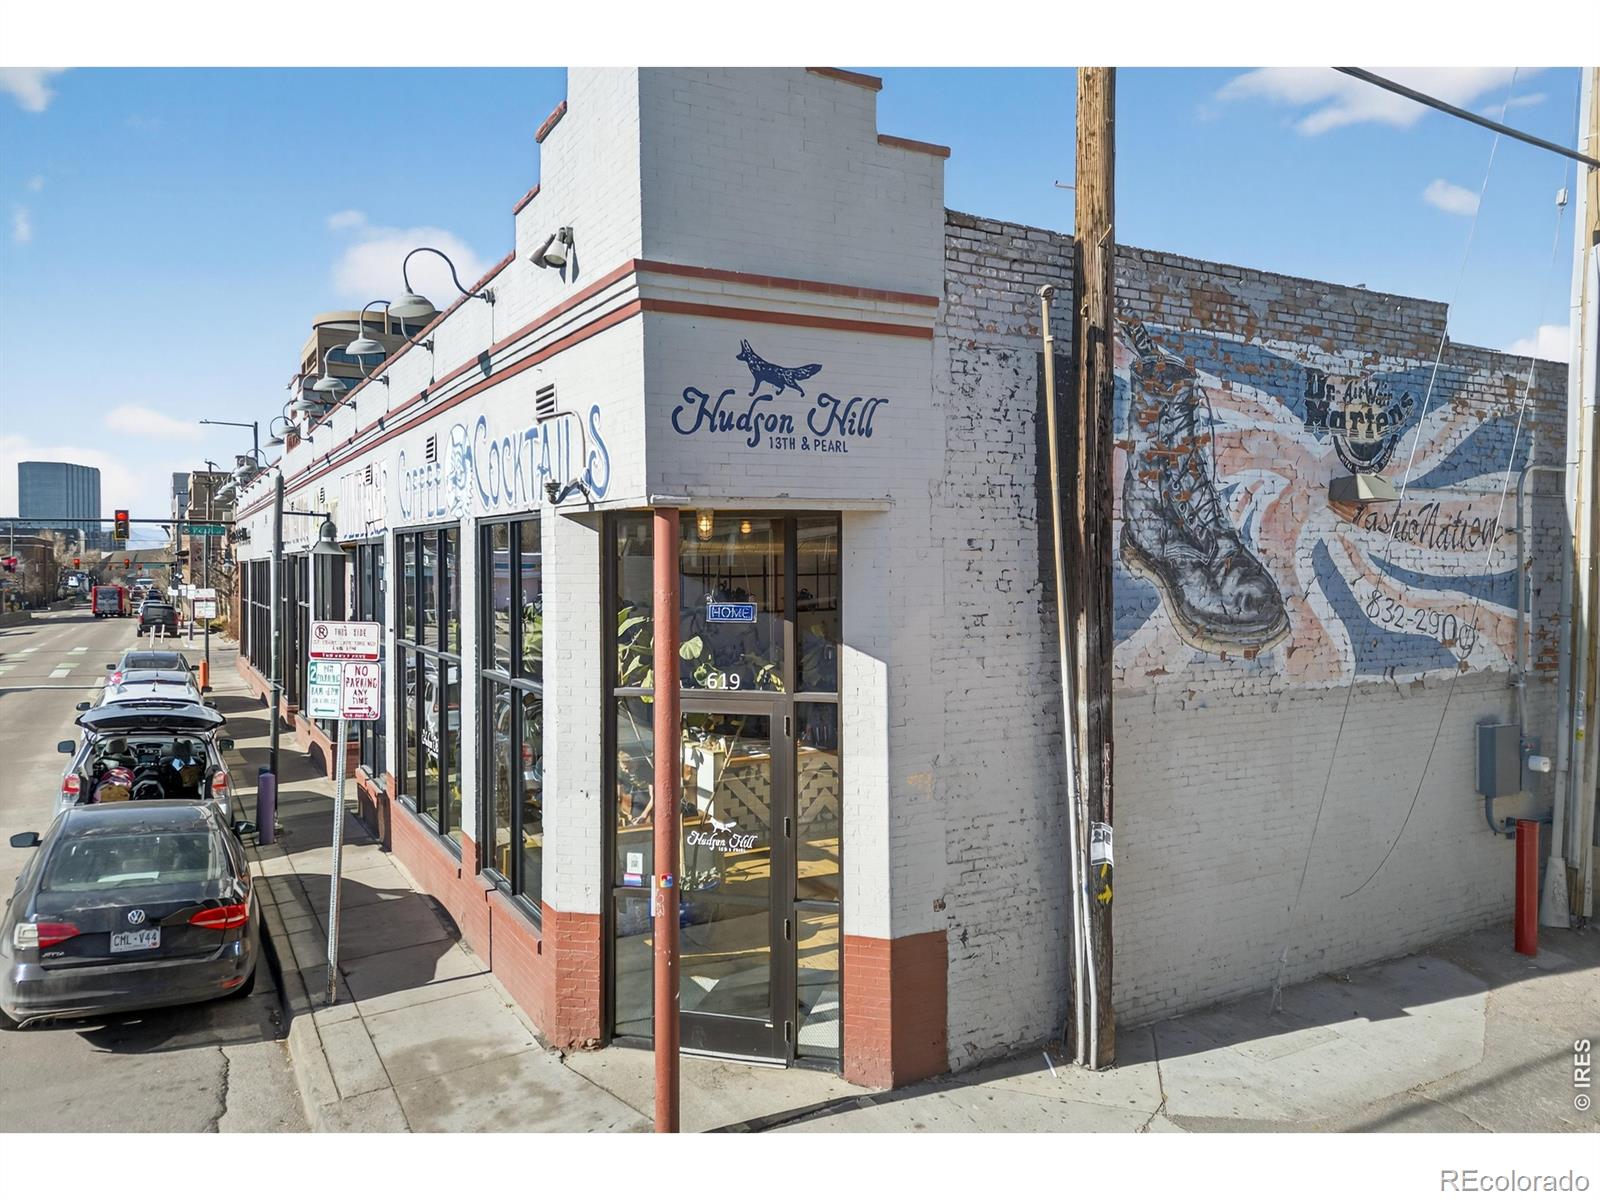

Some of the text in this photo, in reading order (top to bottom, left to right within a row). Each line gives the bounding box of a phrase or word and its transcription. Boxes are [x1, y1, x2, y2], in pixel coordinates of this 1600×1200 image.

[671, 386, 889, 448] Hudson Hill
[769, 436, 848, 453] 13TH & PEARL
[474, 404, 611, 510] COCKTAILS
[711, 605, 752, 619] HOME
[354, 665, 369, 677] NO
[345, 677, 378, 689] PARKING
[707, 672, 741, 690] 619
[352, 688, 368, 697] ANY
[729, 833, 758, 849] Hill
